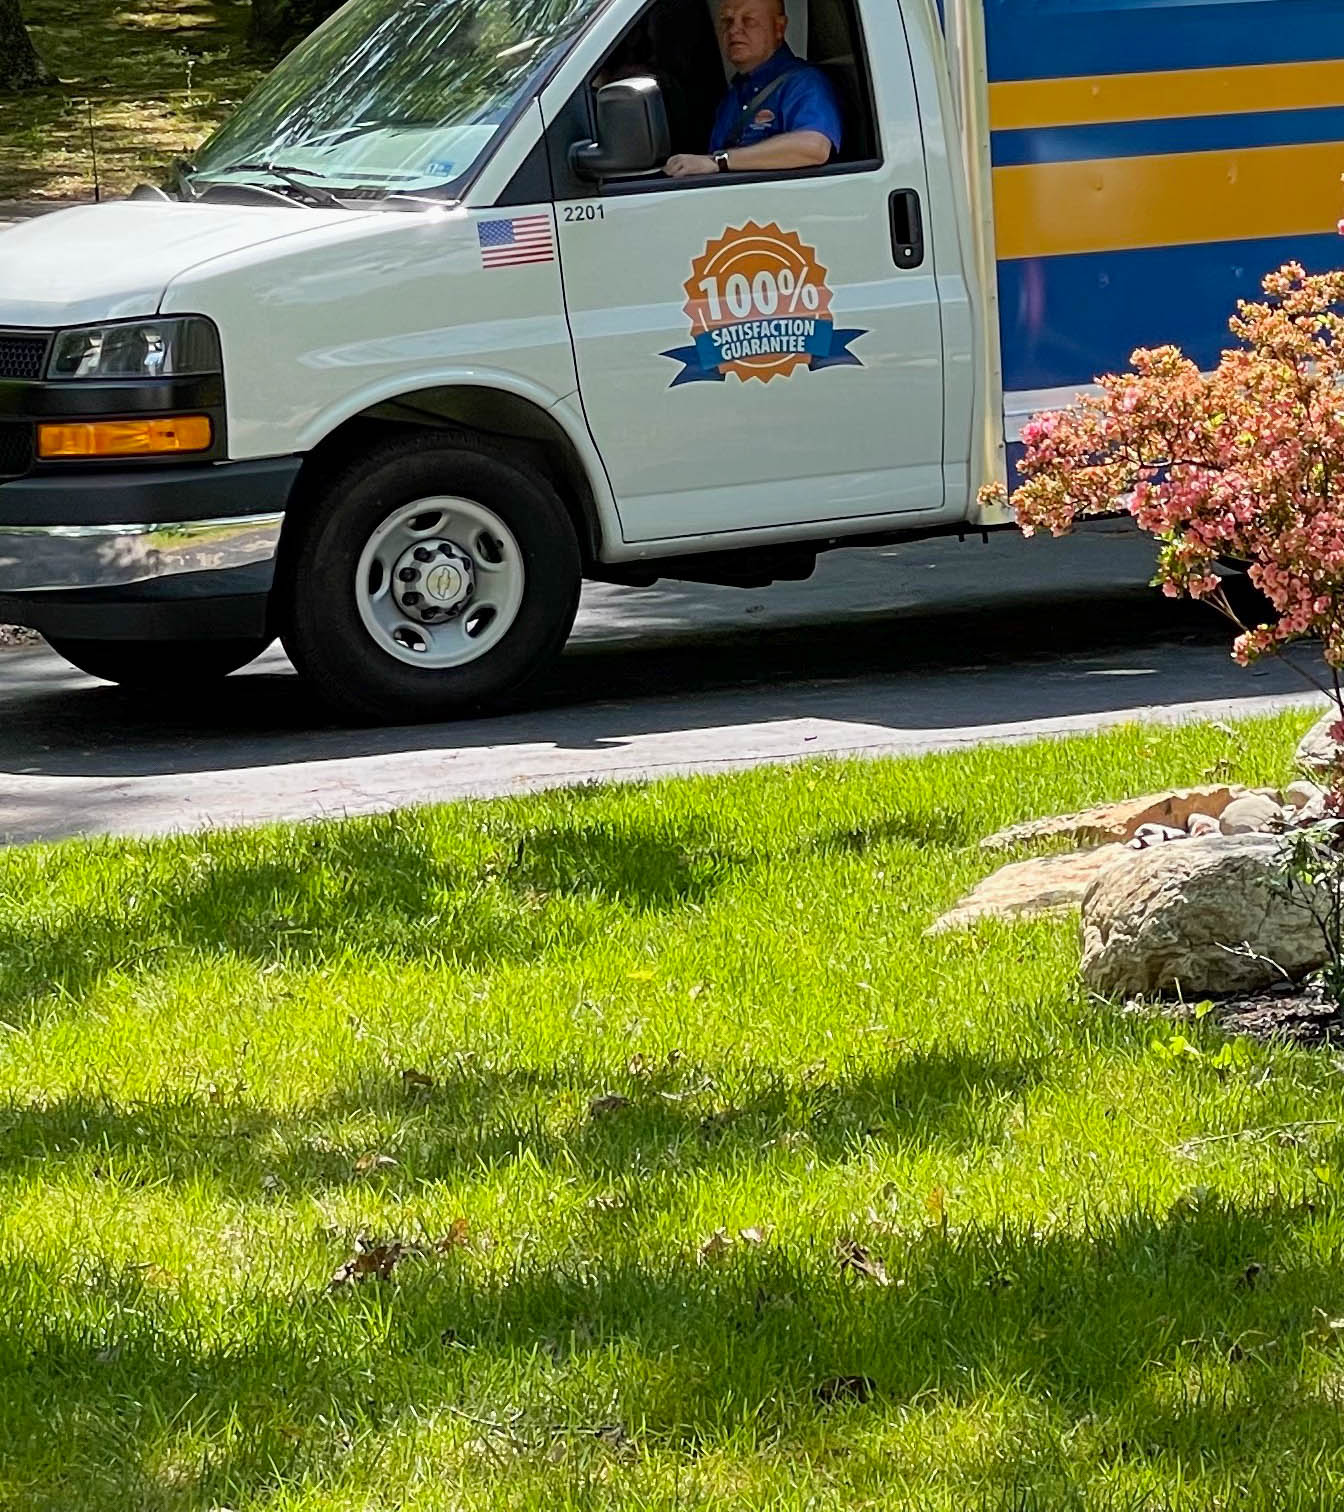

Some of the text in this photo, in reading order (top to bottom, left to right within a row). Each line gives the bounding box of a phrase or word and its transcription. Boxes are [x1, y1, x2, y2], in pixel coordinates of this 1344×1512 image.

[564, 204, 605, 222] 2201
[699, 266, 819, 320] 100%
[711, 319, 815, 347] SATISFACTION
[721, 336, 805, 361] GUARANTEE
